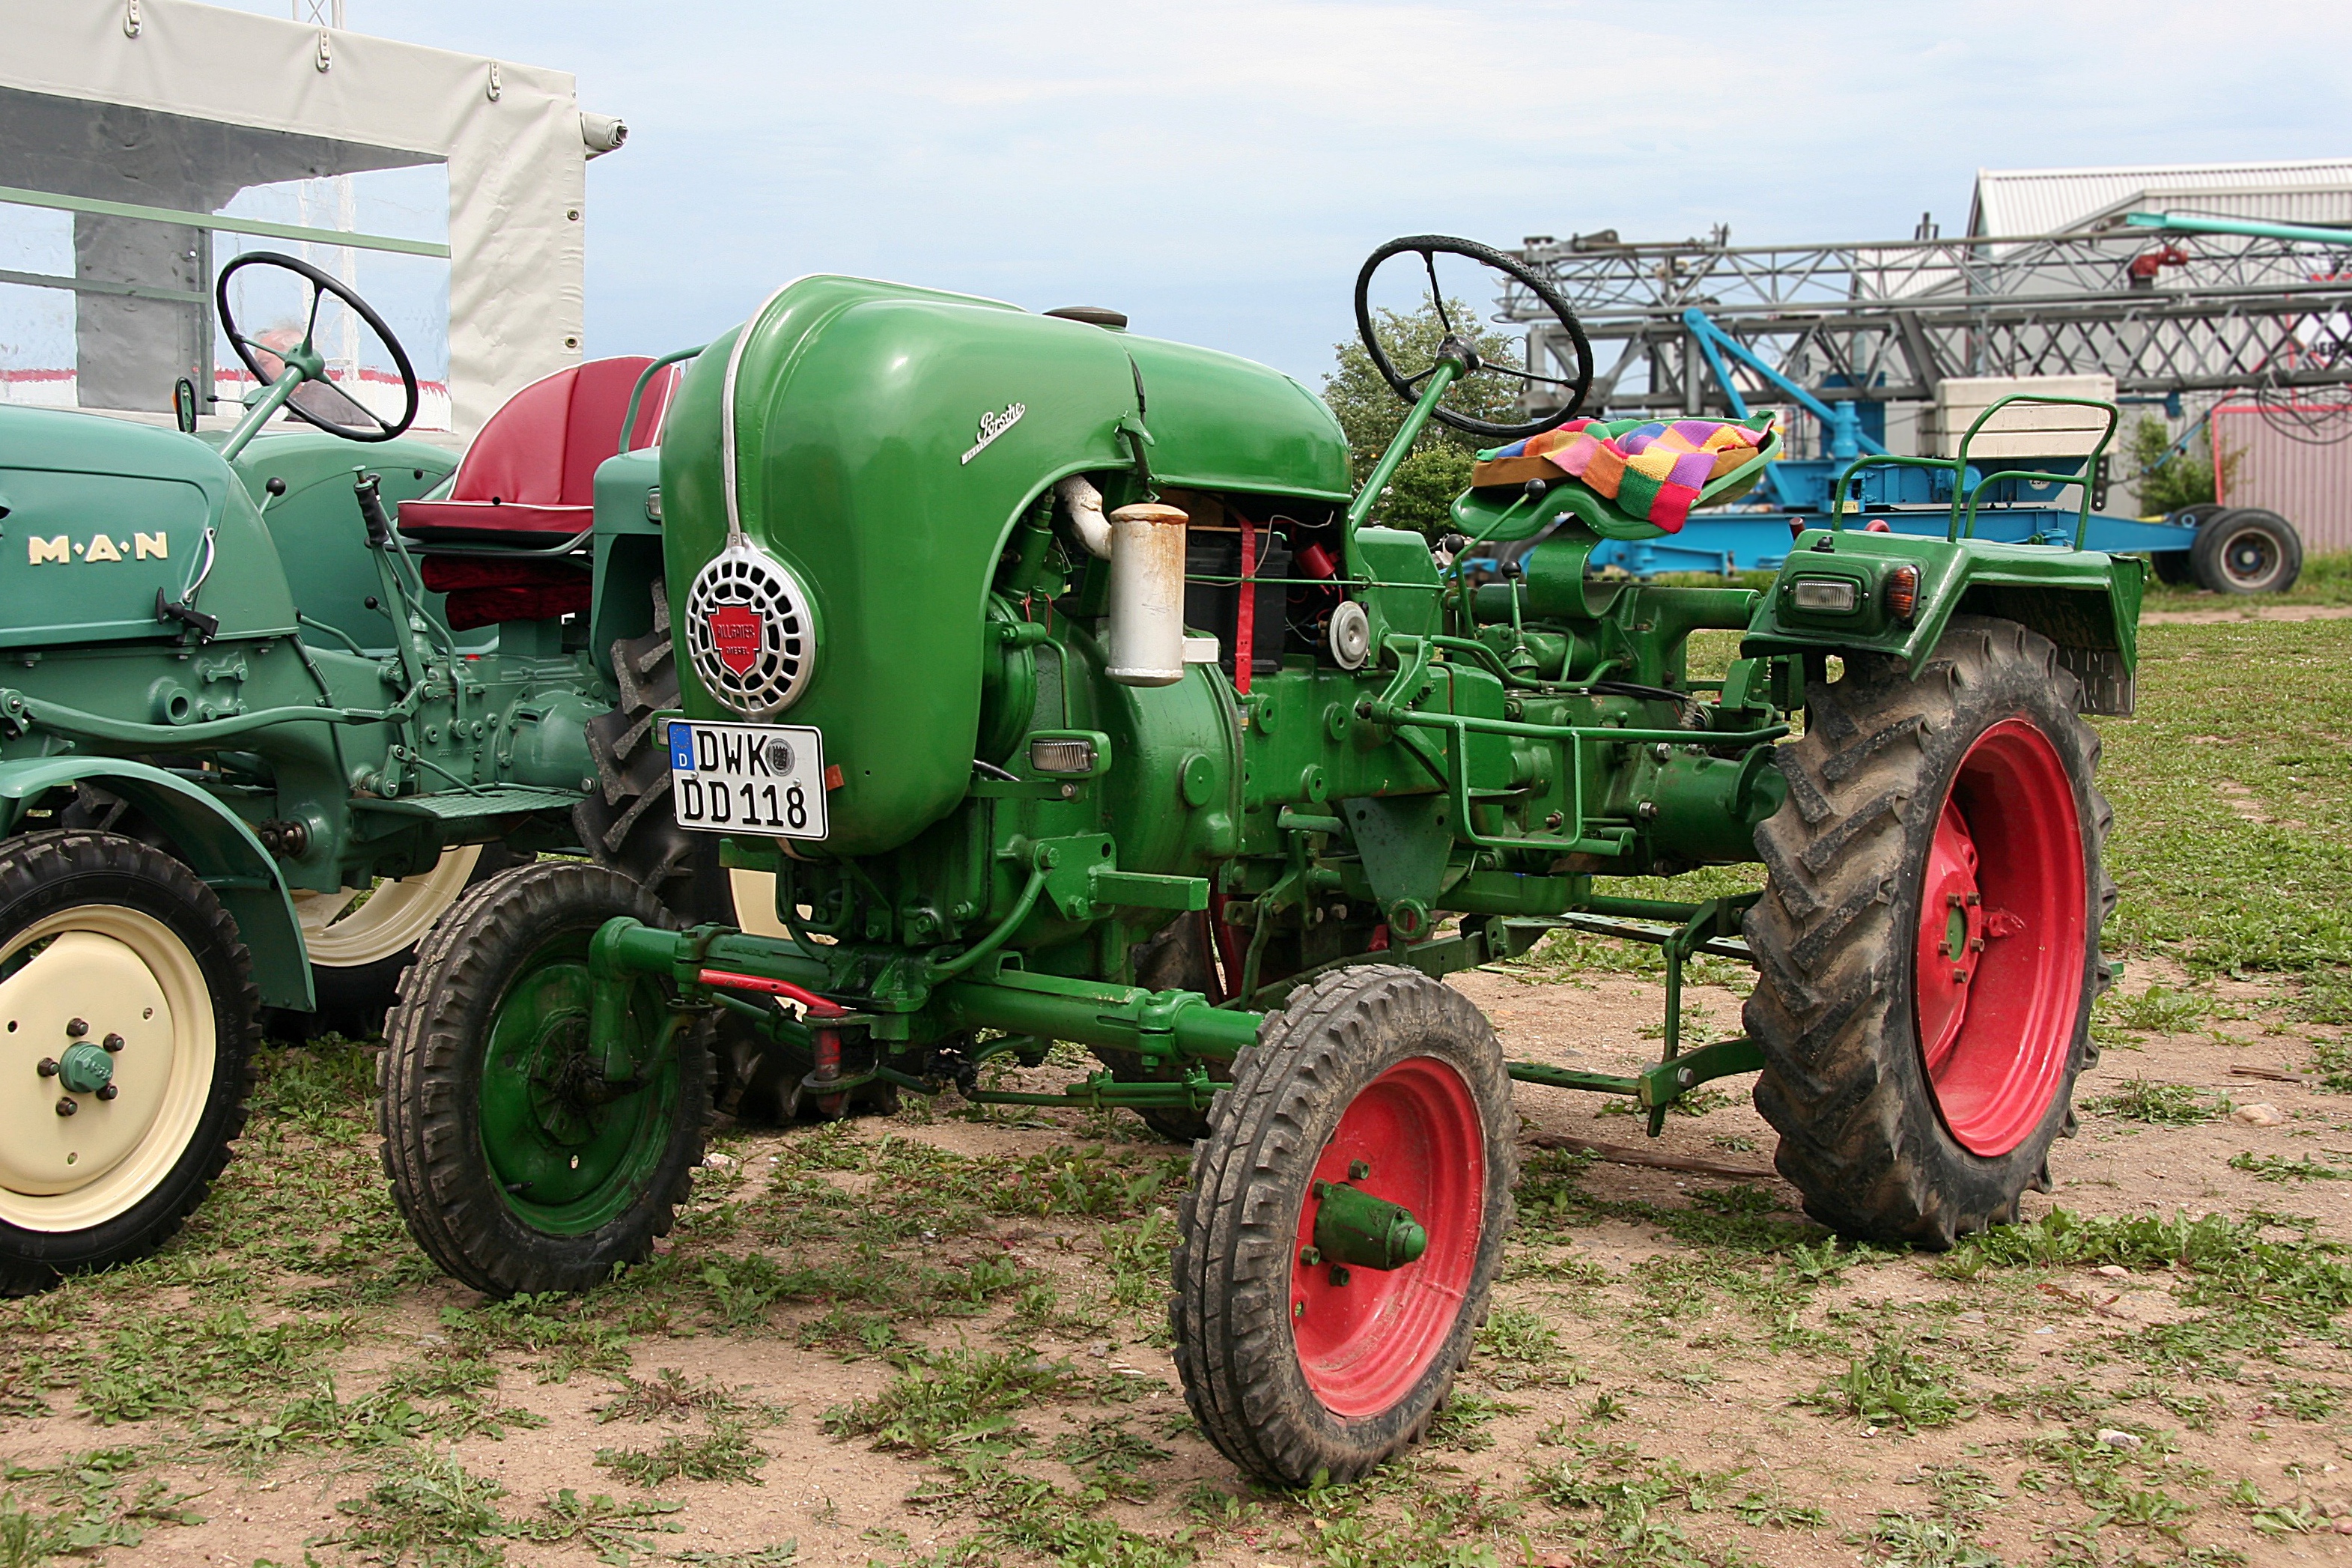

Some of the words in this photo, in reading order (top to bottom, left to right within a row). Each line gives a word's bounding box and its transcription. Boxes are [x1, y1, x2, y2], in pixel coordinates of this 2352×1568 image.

[976, 402, 1026, 443] Porsche
[725, 646, 750, 655] DIESEL
[678, 753, 688, 768] D
[696, 729, 771, 777] DWK
[681, 779, 732, 823] DD
[740, 783, 807, 830] 118
